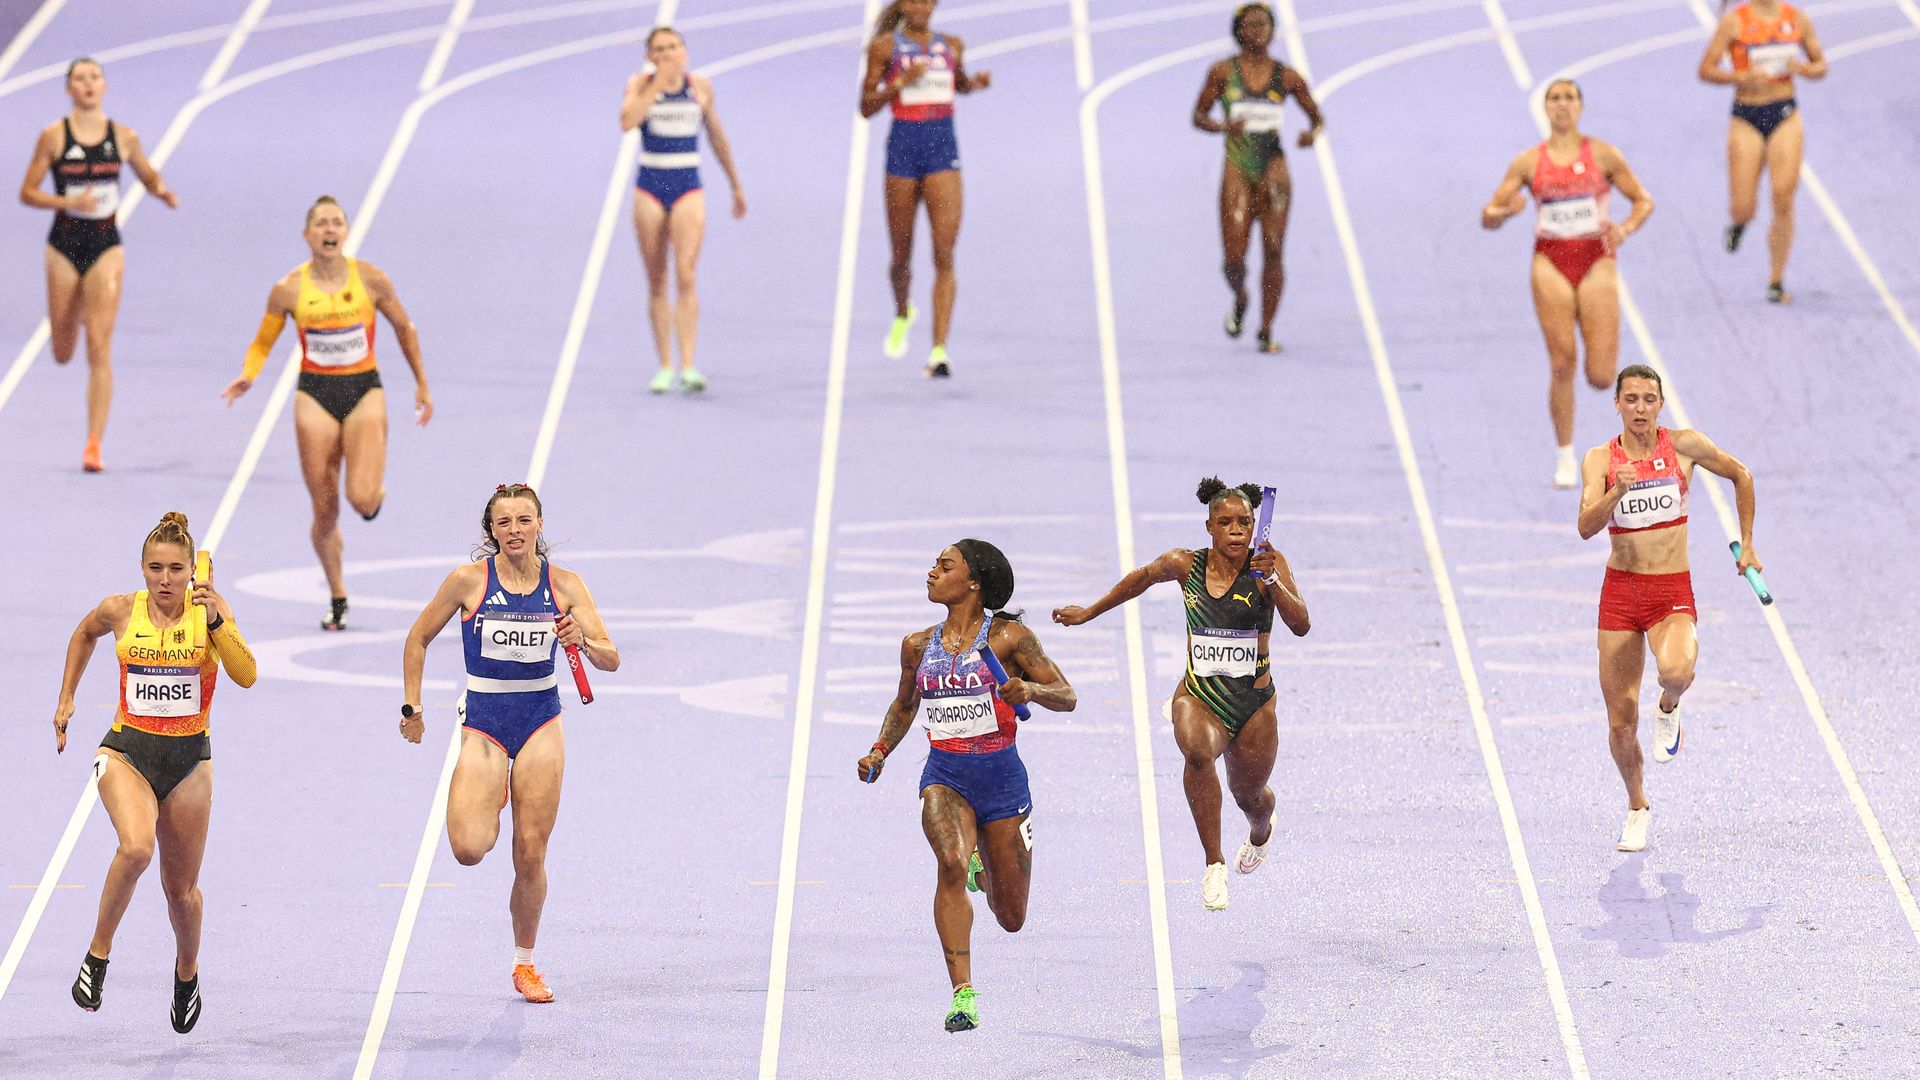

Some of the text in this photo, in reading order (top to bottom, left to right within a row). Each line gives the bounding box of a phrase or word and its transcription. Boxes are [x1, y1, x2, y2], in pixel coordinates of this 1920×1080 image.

[1620, 495, 1673, 514] LEDUC
[492, 630, 547, 647] GALET
[129, 645, 196, 661] GERMANY
[1193, 644, 1255, 662] CLAYTON
[923, 672, 983, 690] USA
[135, 683, 192, 700] HAASE
[926, 700, 992, 723] RICHARDSON
